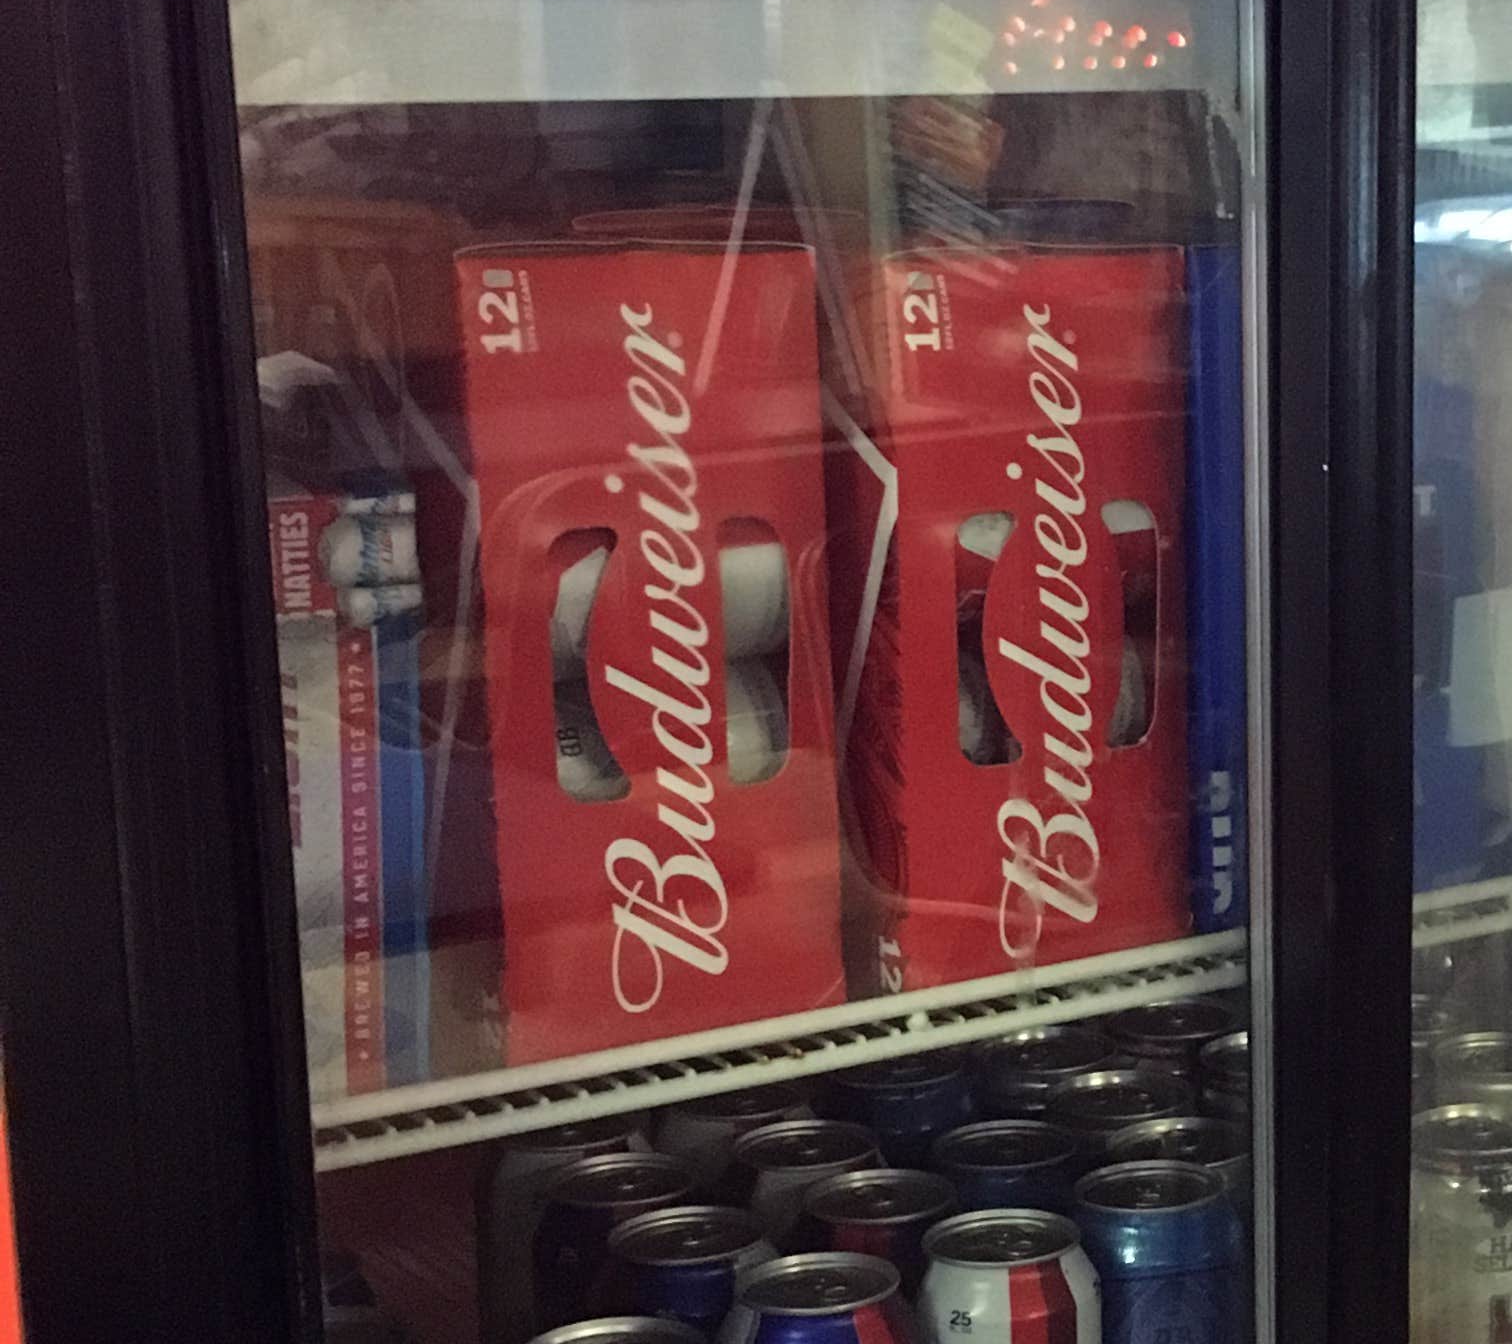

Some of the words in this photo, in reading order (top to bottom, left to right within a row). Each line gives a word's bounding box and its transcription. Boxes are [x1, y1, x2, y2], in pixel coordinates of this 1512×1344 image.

[478, 291, 523, 354] 12
[903, 293, 941, 352] 12
[280, 512, 312, 607] NATTIES
[604, 302, 729, 1014] Budweiser
[997, 302, 1099, 959] Budweiser
[351, 727, 367, 793] SINCE
[353, 805, 369, 906] AMERICA
[355, 912, 370, 939] IN
[355, 951, 371, 1039] BREWED
[949, 1311, 972, 1327] 25
